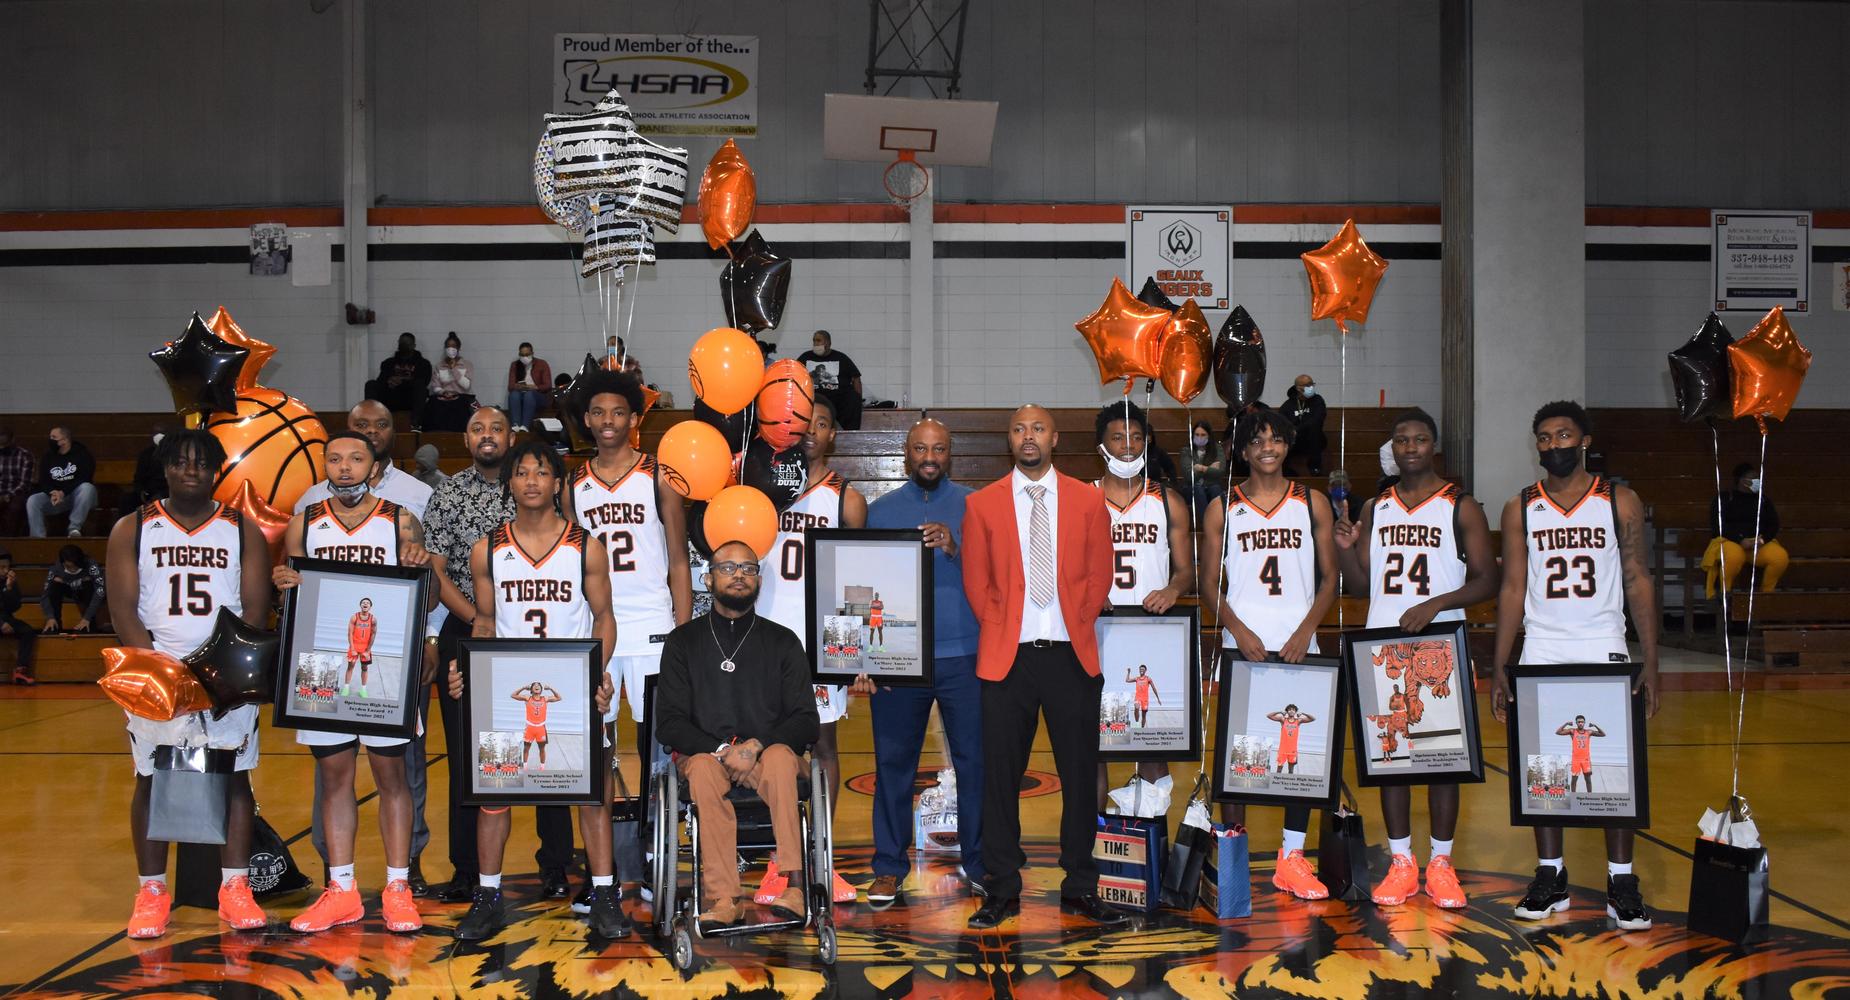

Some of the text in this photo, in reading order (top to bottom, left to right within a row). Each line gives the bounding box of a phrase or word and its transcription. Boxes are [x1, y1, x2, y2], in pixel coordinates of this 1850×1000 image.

[563, 38, 611, 52] Proud
[615, 38, 681, 53] Member
[686, 37, 704, 53] of
[579, 73, 730, 94] LHSAA
[659, 112, 697, 120] ATHLETIC
[698, 112, 751, 121] ASSOCIATION
[1156, 269, 1204, 281] GEAUX
[1158, 282, 1213, 297] IGERS
[777, 472, 798, 480] SLEEP
[778, 464, 797, 473] EAT
[777, 479, 801, 487] DUNK
[583, 502, 645, 530] TIGERS
[778, 510, 829, 533] GERS
[1111, 523, 1159, 544] GERS
[1237, 527, 1303, 553] TIGERS
[1378, 524, 1442, 548] TIGERS
[1532, 526, 1606, 552] TIGERS
[152, 544, 229, 569] TIGERS
[314, 544, 387, 566] TIGERS
[780, 539, 804, 581] 0
[1113, 549, 1137, 590] 5
[1259, 554, 1283, 597] 4
[1383, 552, 1431, 597] 24
[1545, 555, 1597, 600] 23
[168, 573, 213, 616] 15
[501, 579, 573, 603] TIGERS
[524, 608, 548, 639] 3
[1103, 840, 1129, 856] TIME
[1108, 861, 1122, 874] TO
[1097, 886, 1145, 905] LEBRAE
